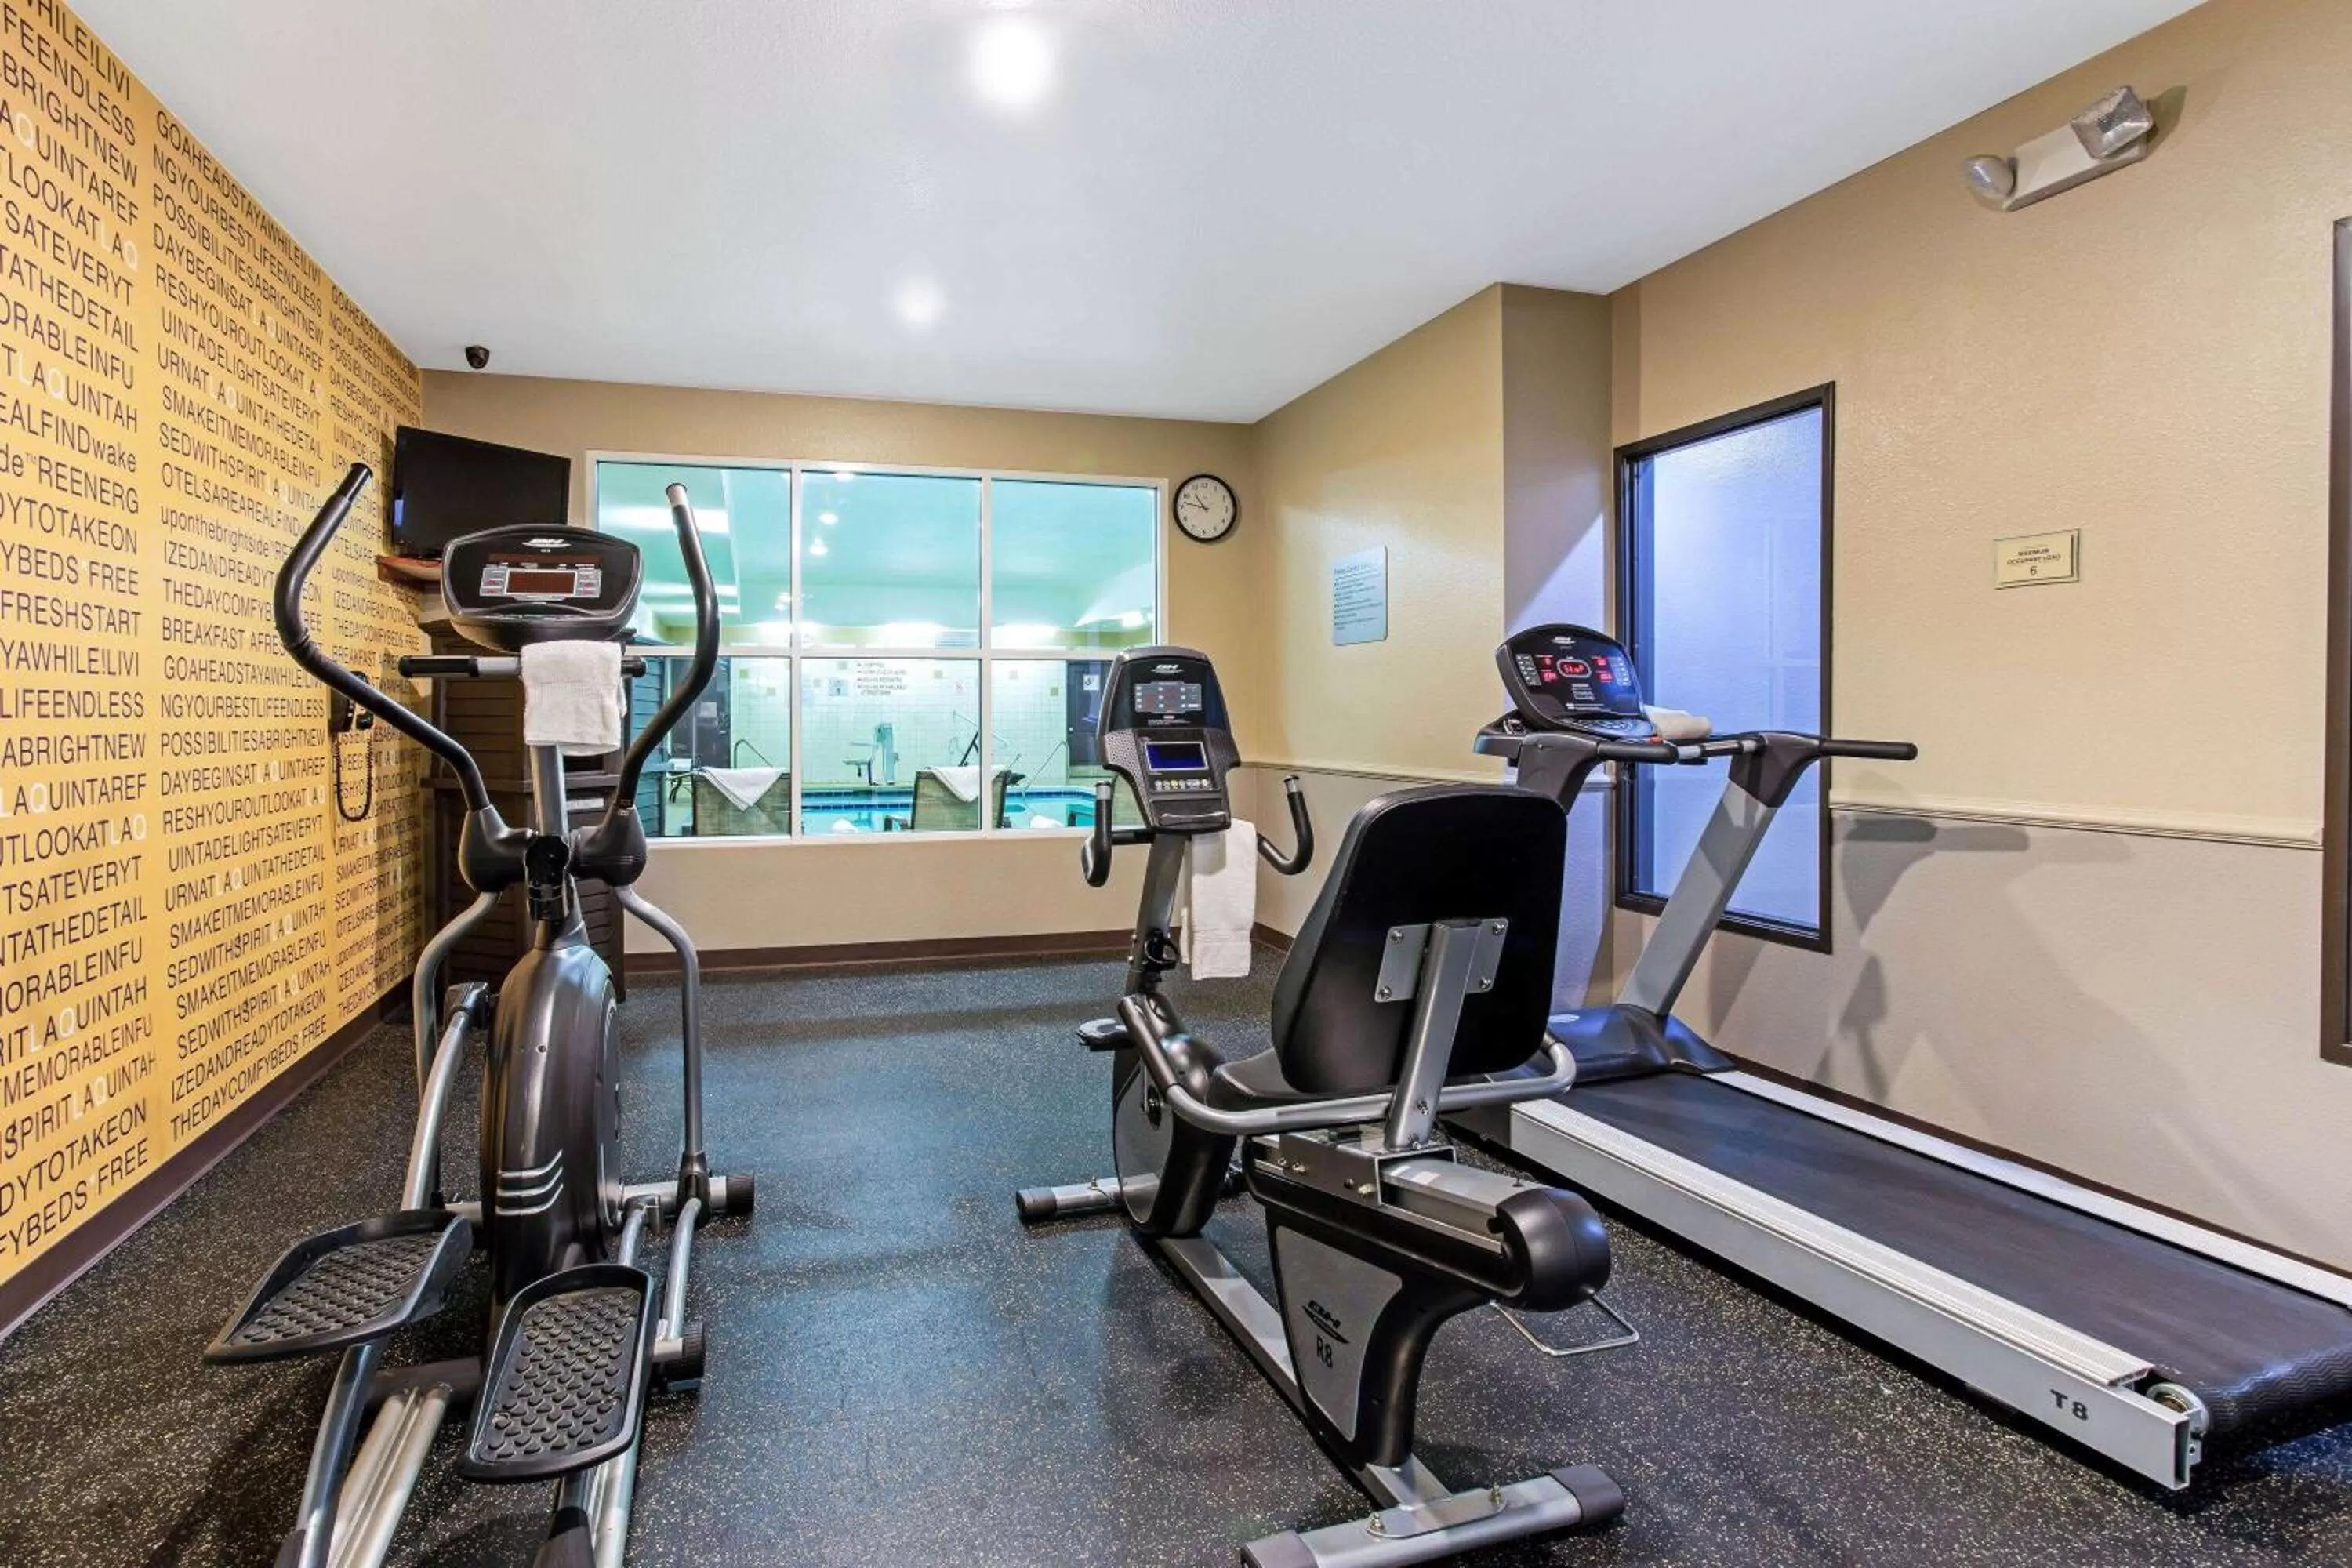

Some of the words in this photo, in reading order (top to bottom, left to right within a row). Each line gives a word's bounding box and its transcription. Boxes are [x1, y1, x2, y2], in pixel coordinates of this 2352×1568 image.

[27, 0, 129, 101] HILE!LIVI
[0, 491, 138, 556] YTOTAKEON
[89, 560, 139, 597] FREE
[0, 813, 147, 866] TLOOKATLAQ
[0, 937, 143, 1017] ORABLEINFU
[0, 1012, 153, 1108] MEMORABLEINFU
[0, 1047, 158, 1165] SPIRITLAQUINTAH
[98, 1137, 149, 1196] FREE
[1316, 1334, 1333, 1369] R8
[2049, 1388, 2089, 1421] T8
